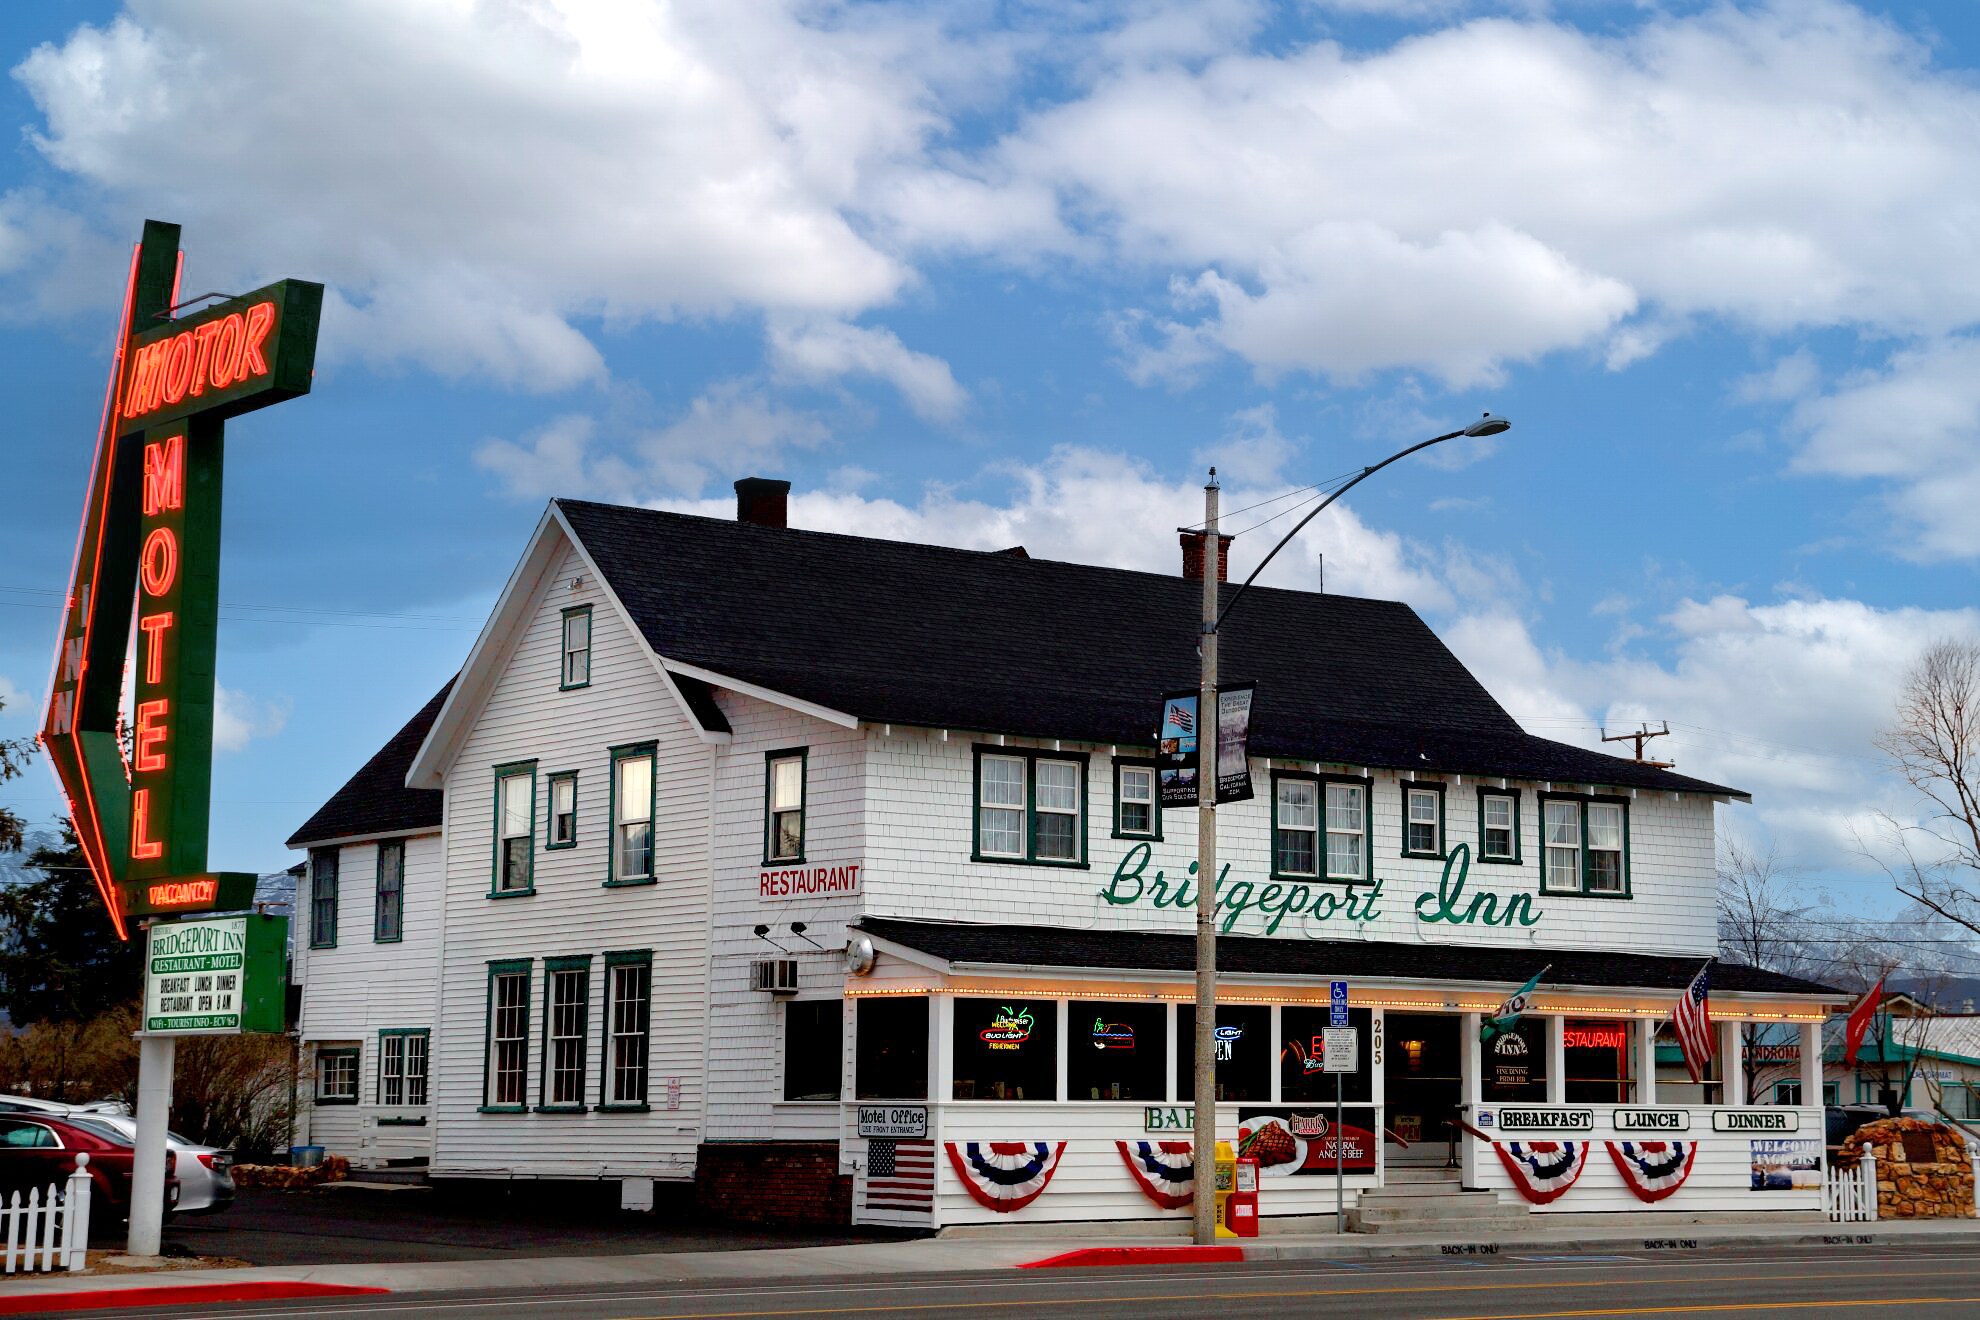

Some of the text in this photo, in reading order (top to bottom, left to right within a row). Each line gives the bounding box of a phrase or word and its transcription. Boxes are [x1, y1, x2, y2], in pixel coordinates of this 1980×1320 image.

[123, 301, 275, 417] MOTOR
[131, 434, 183, 860] MOTEL
[760, 866, 859, 896] RESTAURANT
[1415, 842, 1543, 926] Inn
[149, 880, 216, 905] VACANCY
[231, 920, 245, 930] 1877
[153, 926, 244, 956] BRIDGEPORT INN
[154, 955, 241, 972] RESTAURANT MOTEL
[161, 975, 236, 993] BREAKFAST LUNCH DINNER
[161, 994, 231, 1012] RESTAURANT OPEN 8 AM
[168, 1017, 193, 1028] TOURIST
[194, 1016, 209, 1027] INFO
[1374, 1019, 1382, 1065] 205
[1562, 1032, 1626, 1048] ESTAURANT
[860, 1109, 924, 1124] Motel Office
[1503, 1112, 1590, 1128] BREAKFAST
[1625, 1112, 1680, 1128] LUNCH
[1727, 1114, 1786, 1128] DINNER
[891, 1126, 915, 1134] ENTRANCE
[1319, 1149, 1364, 1159] ANGS BEEF
[1441, 1244, 1500, 1255] BACK-IN ONLY
[1645, 1239, 1697, 1250] BACK-IN ONLY
